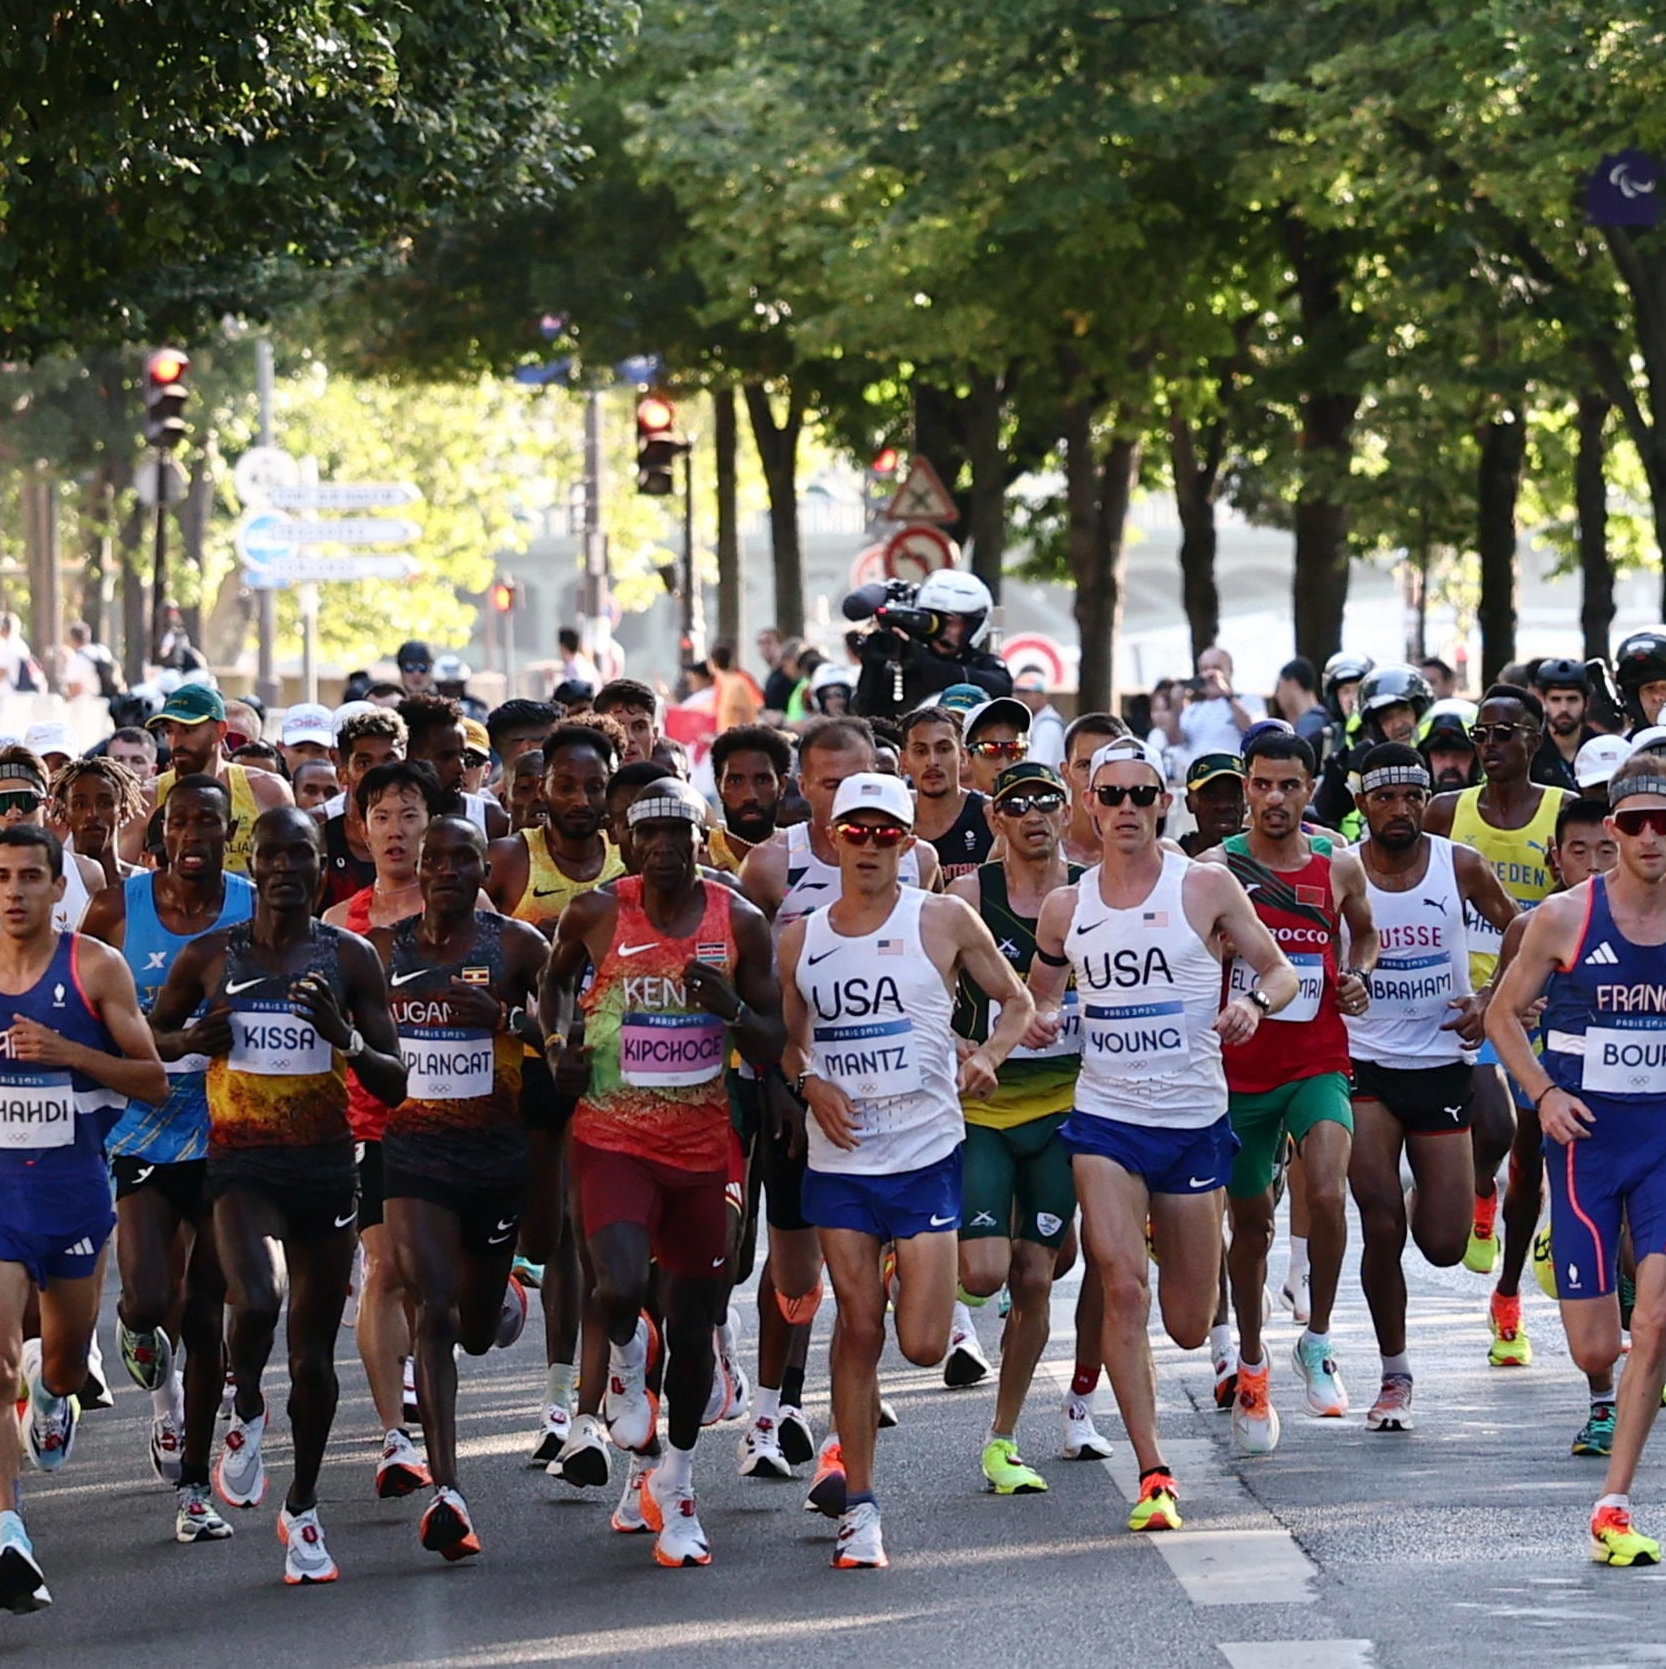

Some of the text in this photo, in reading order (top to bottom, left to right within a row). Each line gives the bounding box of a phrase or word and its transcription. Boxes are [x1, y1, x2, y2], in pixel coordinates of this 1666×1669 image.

[1494, 862, 1546, 888] EDEN
[1083, 947, 1175, 990] USA
[623, 977, 693, 1009] KEN
[812, 976, 905, 1022] USA
[1103, 1008, 1131, 1018] PARIS
[243, 1025, 316, 1051] KISSA
[623, 1034, 723, 1062] KIPCHOGE
[1091, 1027, 1182, 1054] YOUNG
[824, 1046, 909, 1078] MANTZ
